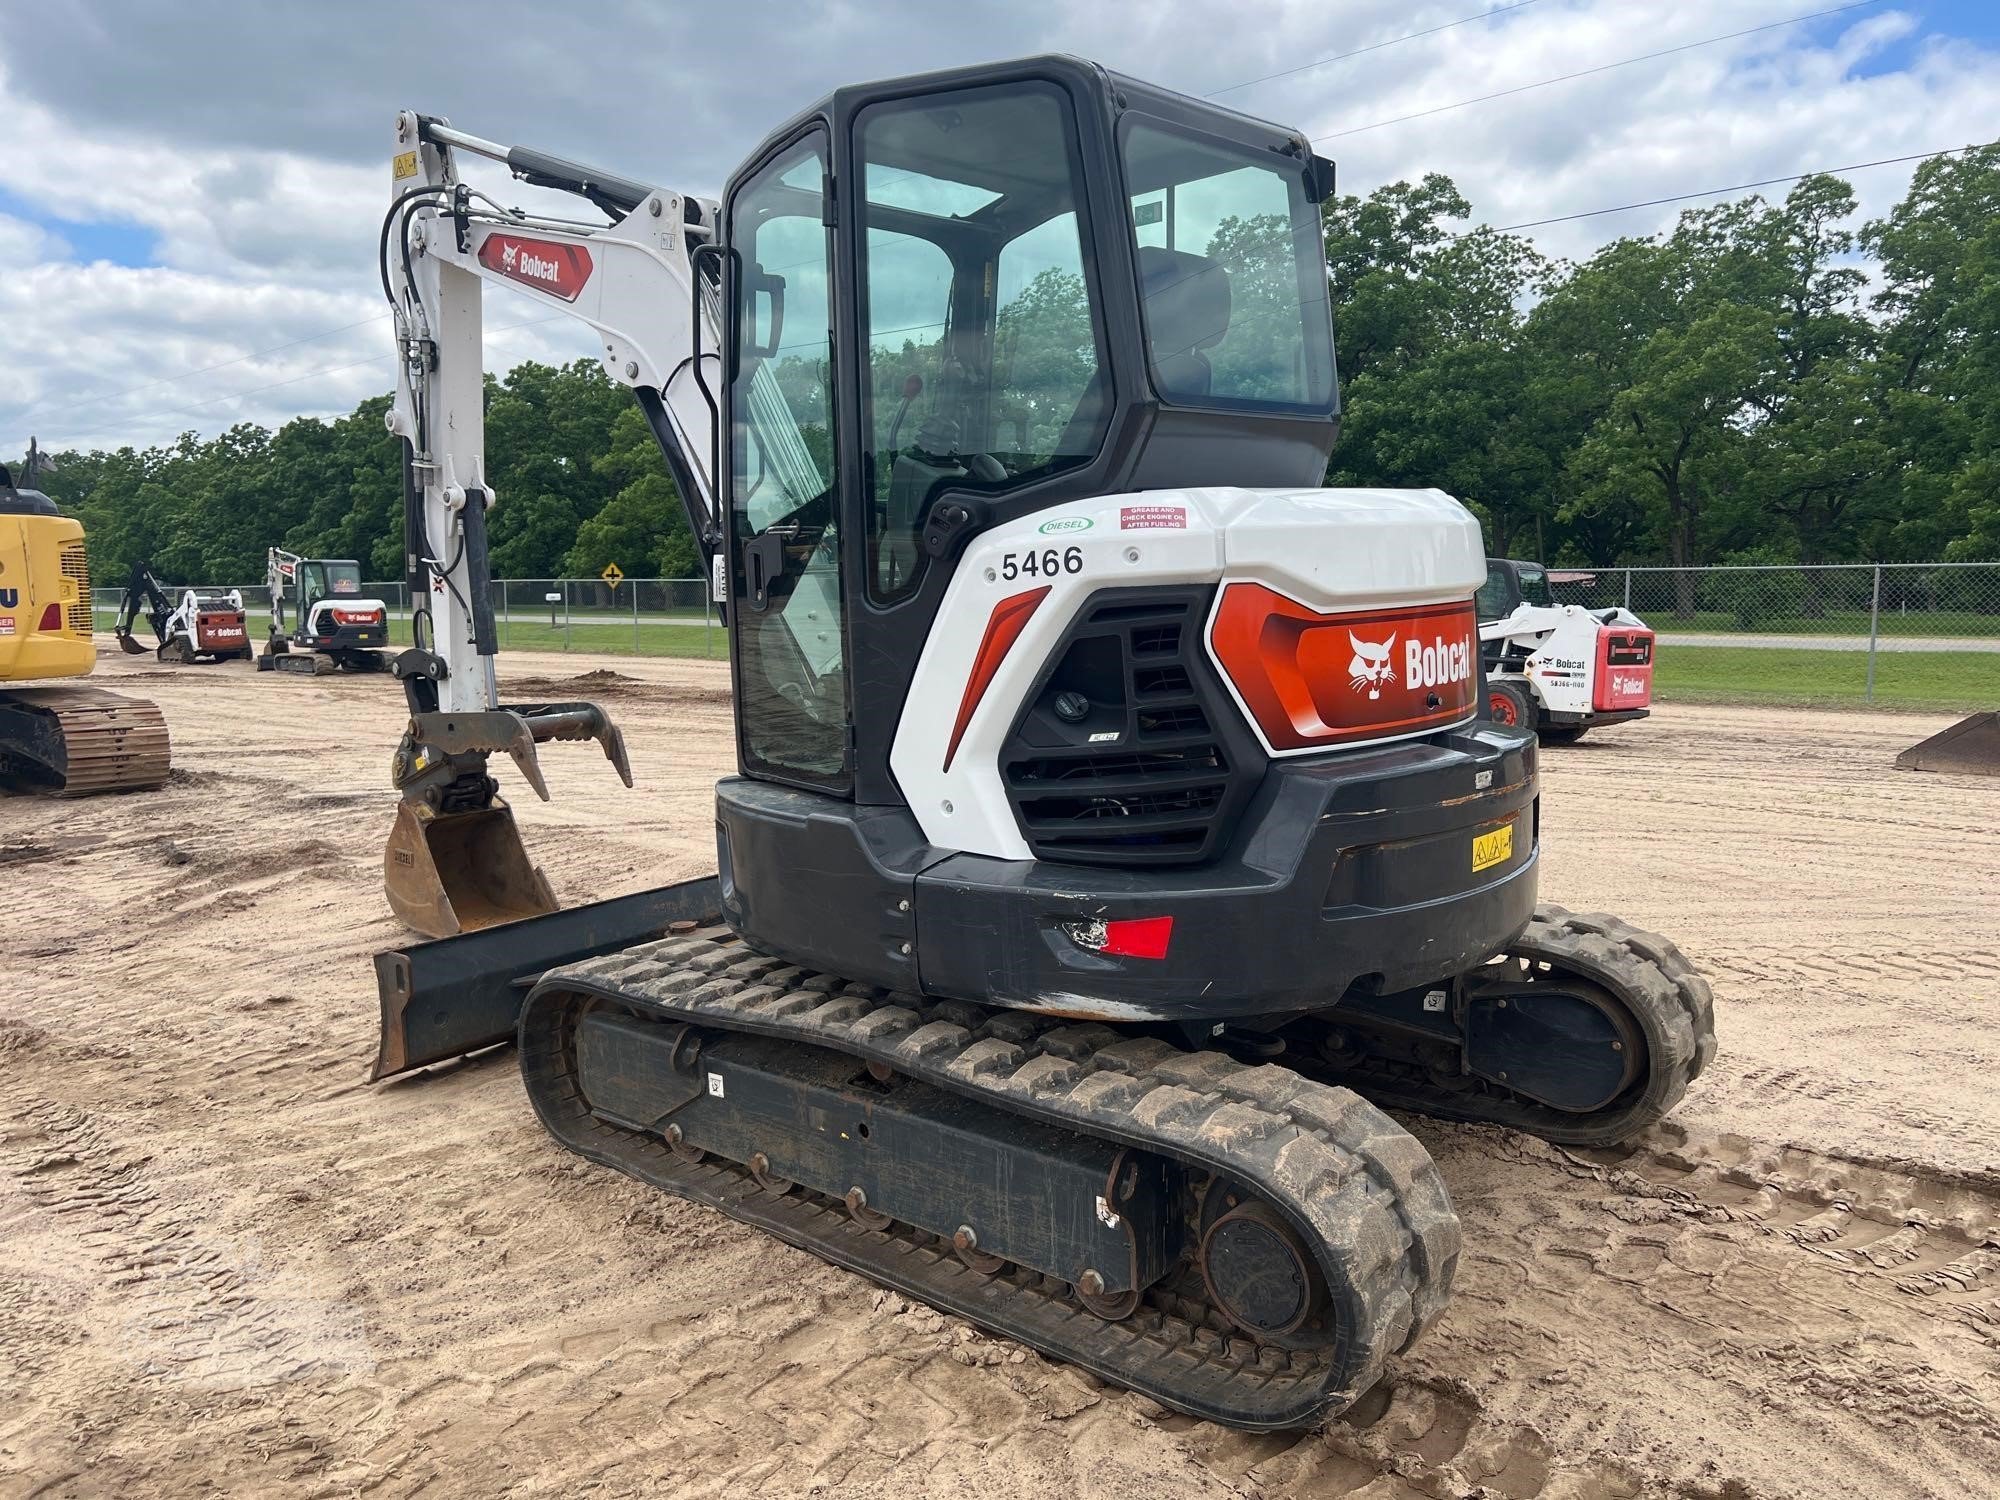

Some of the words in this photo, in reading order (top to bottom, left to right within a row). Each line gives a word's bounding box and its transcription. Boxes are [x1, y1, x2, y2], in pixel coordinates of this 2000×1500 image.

[520, 252, 558, 282] Bobcat
[1046, 521, 1083, 530] DIESEL
[1002, 546, 1083, 581] 5466
[217, 628, 242, 637] Bobcat
[1405, 633, 1469, 690] Bobcat
[1556, 659, 1584, 669] Bobcat
